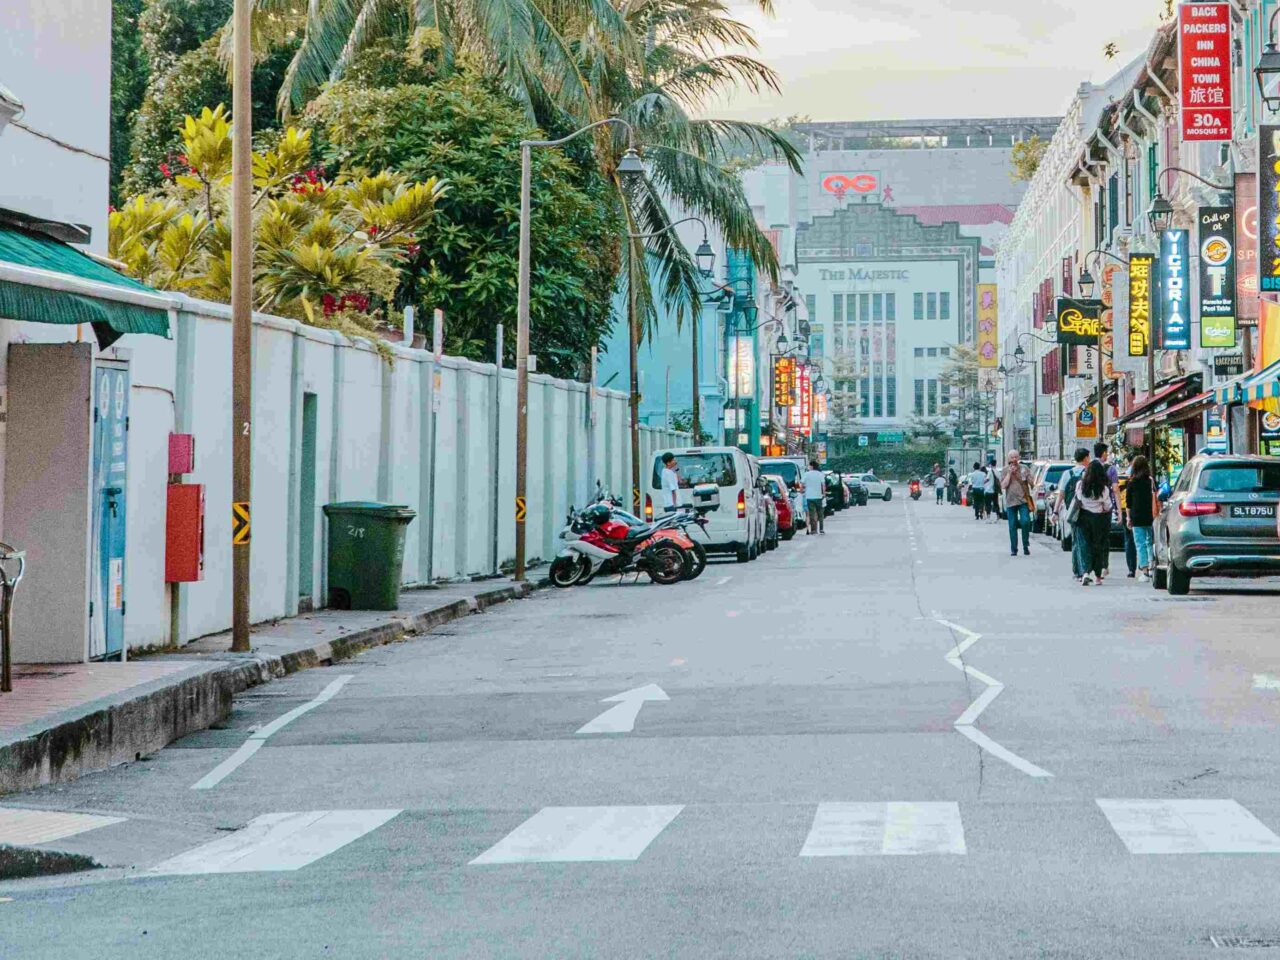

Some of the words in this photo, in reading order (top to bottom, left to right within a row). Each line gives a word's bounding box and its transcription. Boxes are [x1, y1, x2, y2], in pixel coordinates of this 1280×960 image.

[1191, 7, 1218, 17] BACK
[1183, 24, 1227, 34] PACKERS
[1196, 41, 1214, 50] INN
[1190, 57, 1221, 67] CHINA
[1192, 74, 1220, 84] TOWN
[1190, 87, 1224, 104] 旅馆
[822, 175, 877, 192] OG
[1220, 213, 1230, 222] up
[819, 269, 845, 280] THE
[848, 268, 909, 281] MAJESTIC
[1167, 231, 1184, 324] VICTORIA
